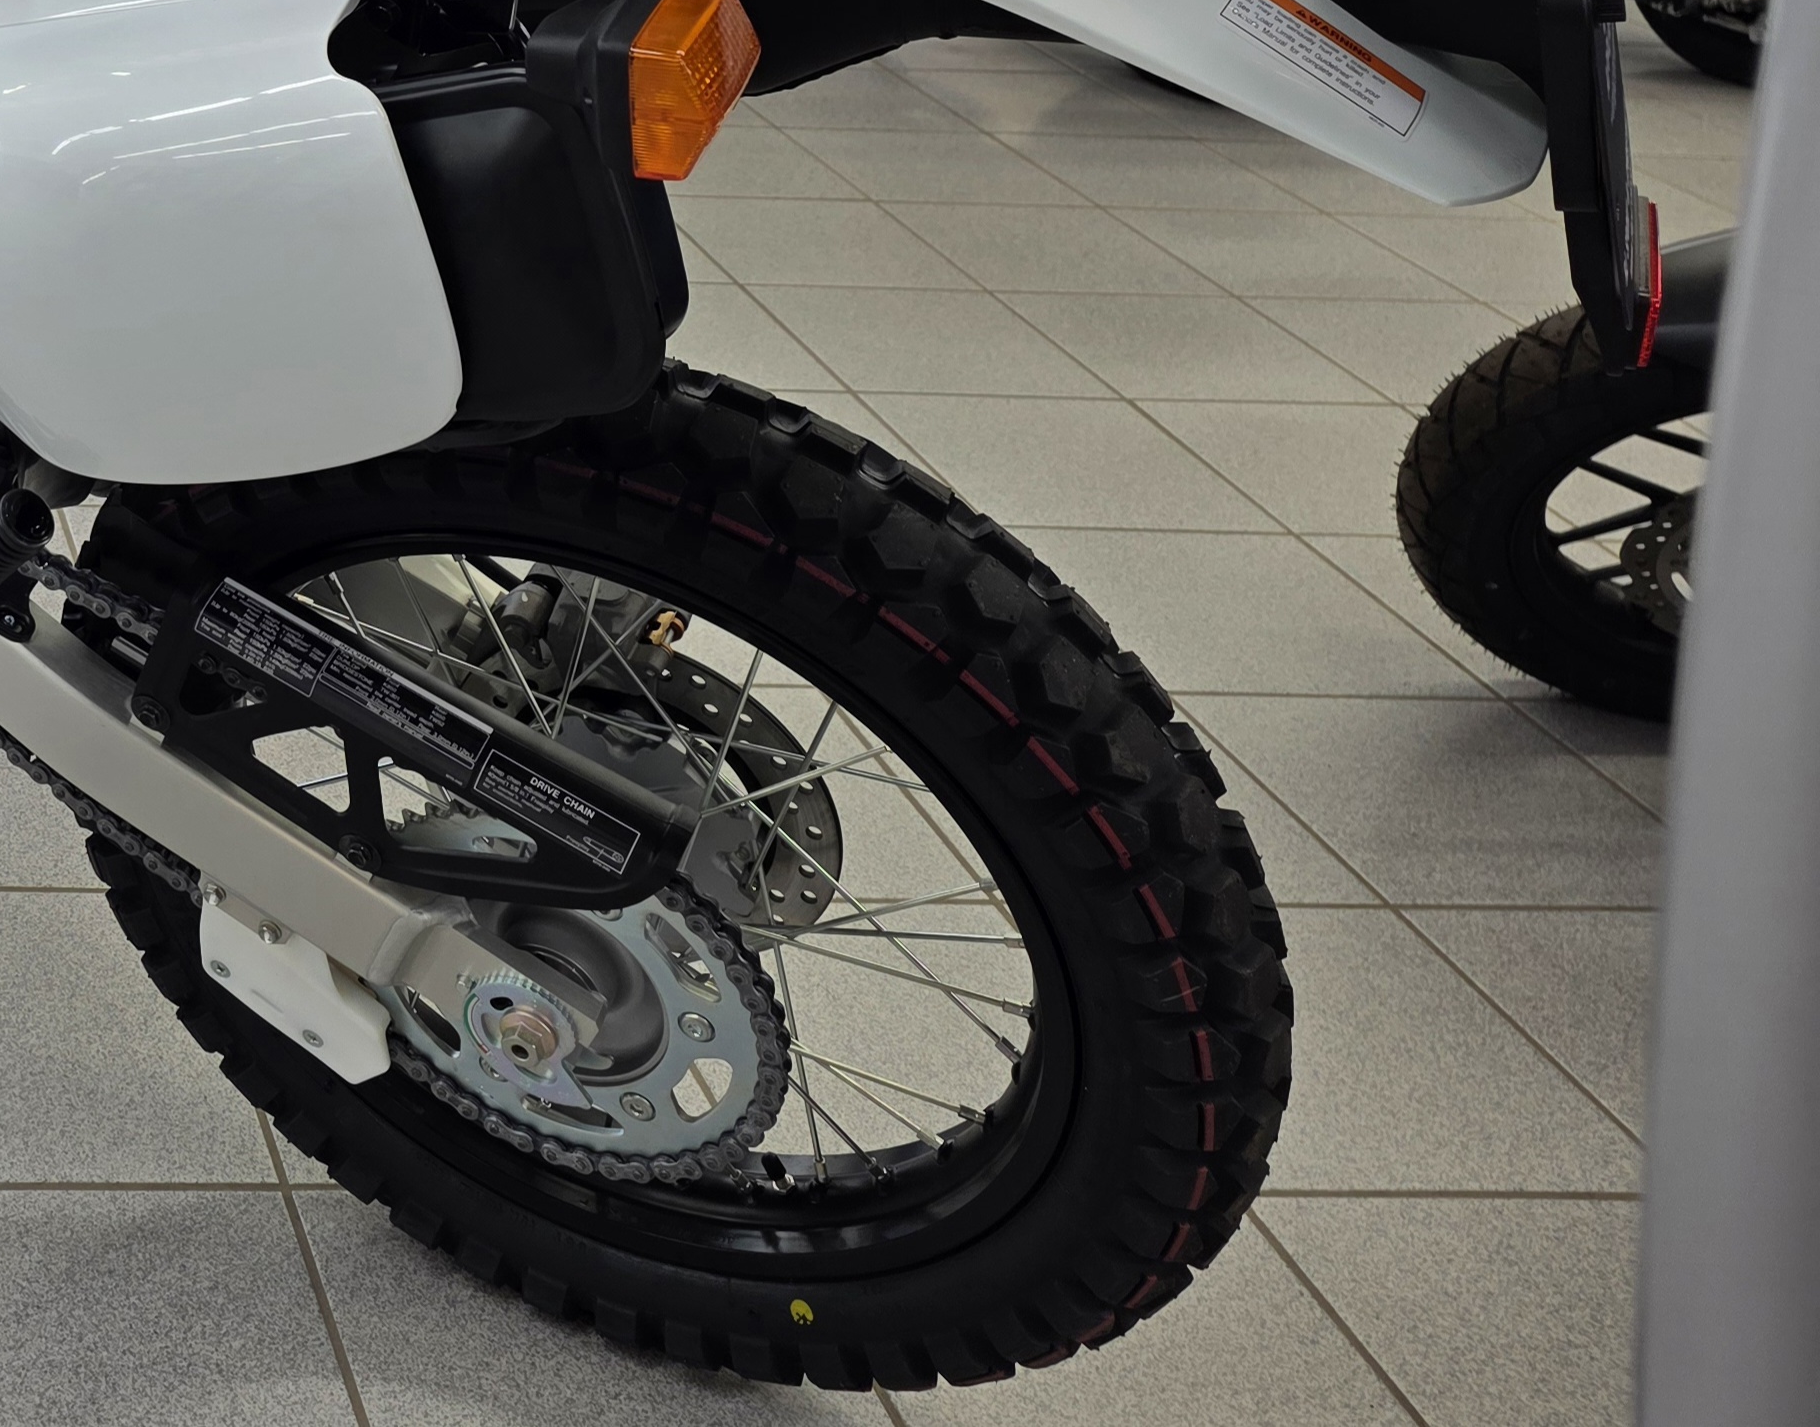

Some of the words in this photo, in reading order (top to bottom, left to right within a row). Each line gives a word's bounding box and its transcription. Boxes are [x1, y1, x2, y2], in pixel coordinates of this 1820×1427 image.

[1235, 0, 1251, 13] See
[1274, 26, 1296, 43] Limits
[1297, 41, 1312, 54] and
[1313, 51, 1354, 81] Guidelines"
[1363, 86, 1380, 101] your
[1255, 4, 1271, 16] may
[1273, 15, 1284, 24] be
[1285, 23, 1316, 46] seriously
[1318, 44, 1333, 56] hurt
[1334, 55, 1342, 63] or
[1306, 14, 1373, 63] WARNING
[1261, 27, 1288, 47] Manual
[1288, 45, 1300, 55] for
[1300, 54, 1333, 78] complete
[1335, 76, 1375, 106] instructions.
[1371, 73, 1386, 85] and
[331, 658, 374, 685] BRIDGESTONE
[335, 654, 361, 671] DUNLOP
[505, 774, 522, 786] chain
[548, 798, 560, 808] and
[528, 775, 561, 799] DRIVE
[561, 794, 596, 819] CHAIN
